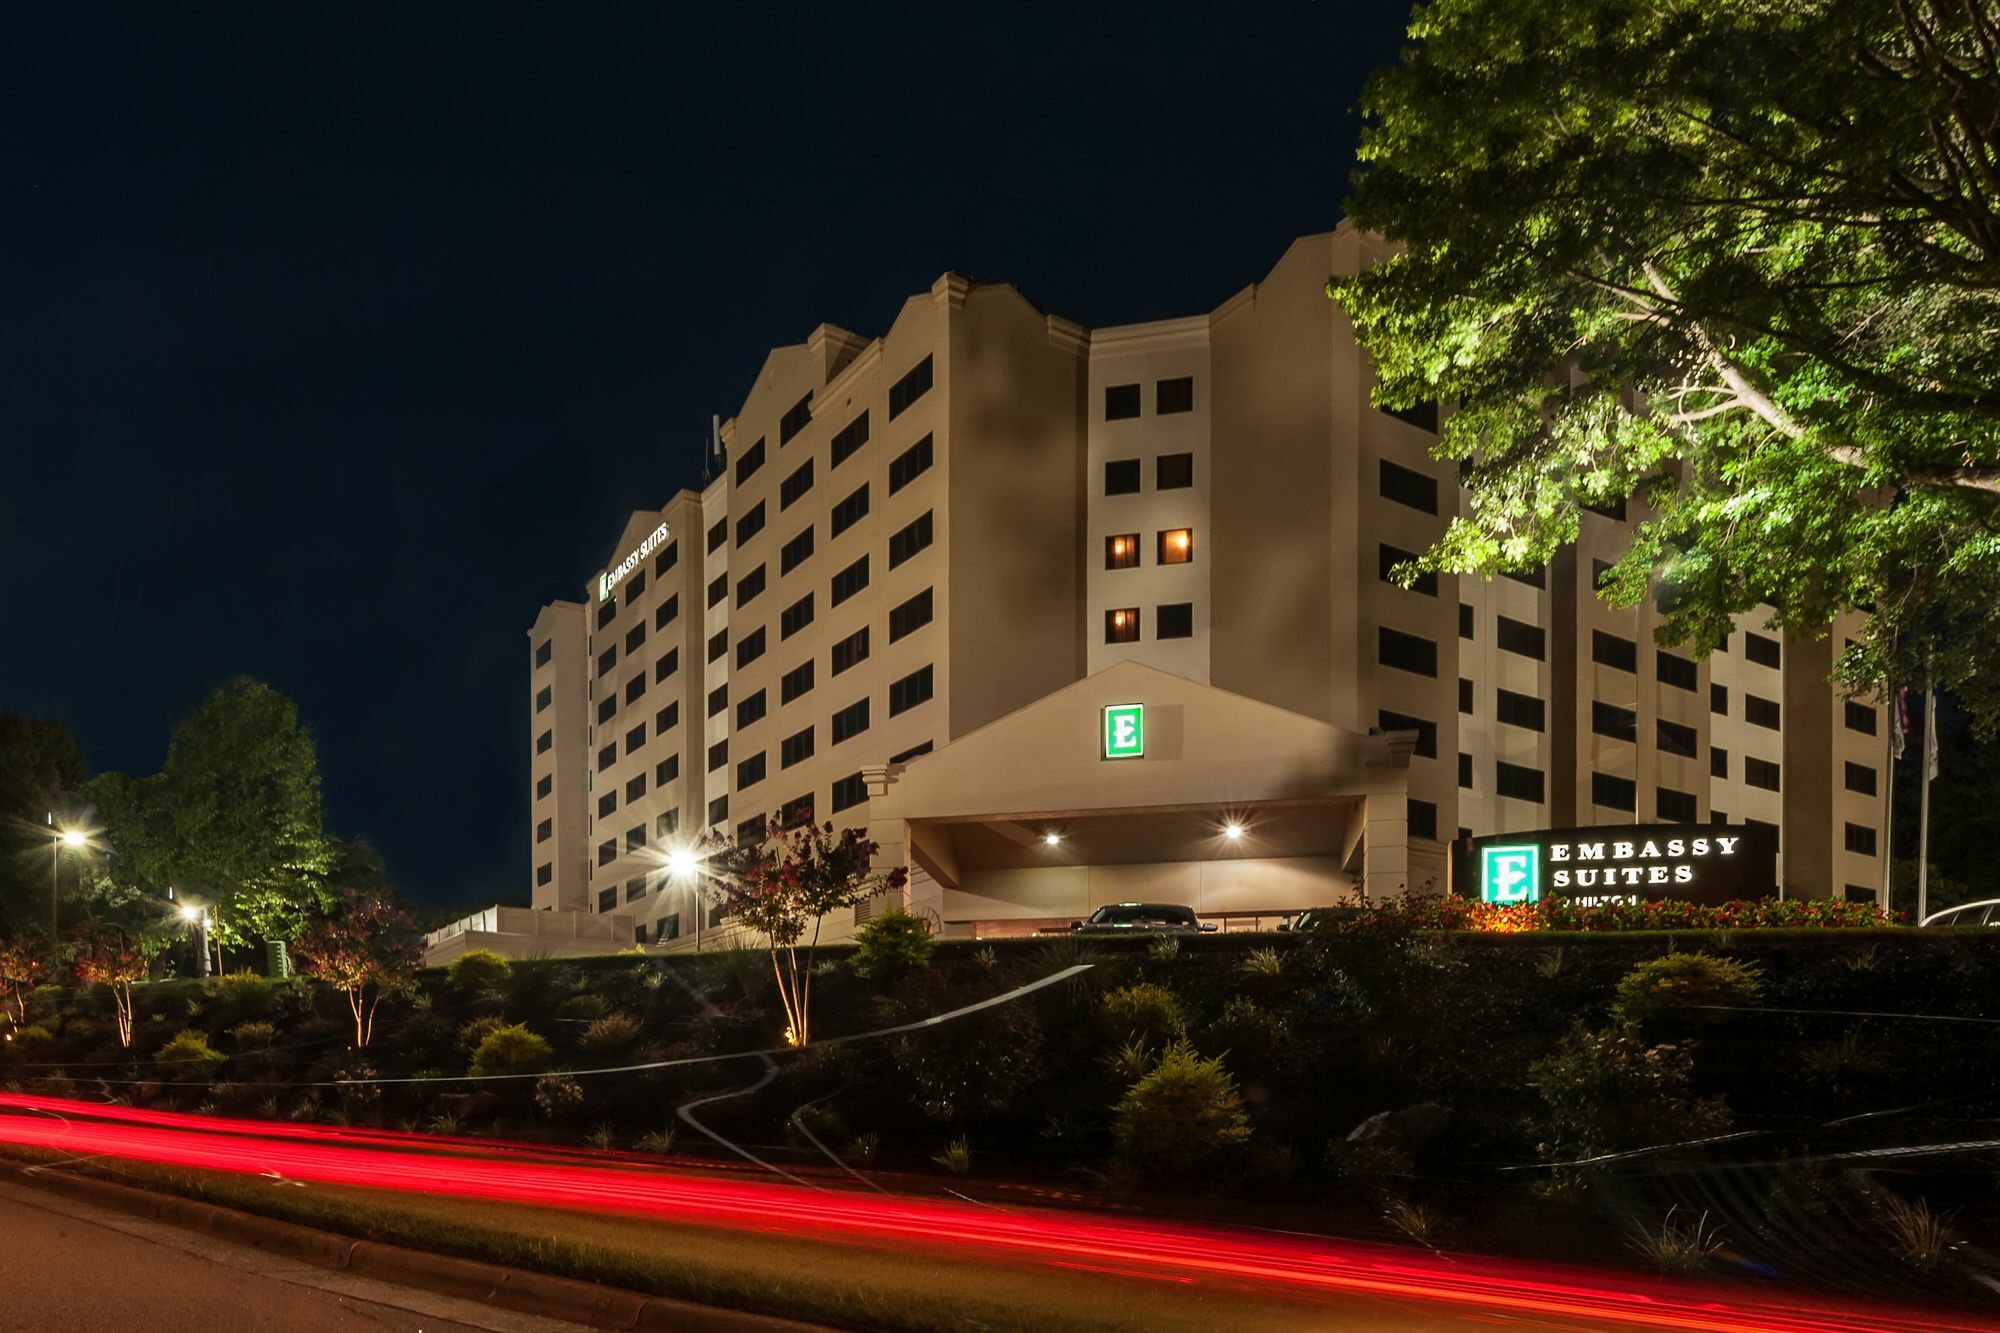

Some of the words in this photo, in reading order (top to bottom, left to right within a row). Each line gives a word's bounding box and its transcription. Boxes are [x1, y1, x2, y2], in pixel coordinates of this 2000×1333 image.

[608, 548, 640, 590] EMBASSY
[640, 522, 669, 560] SUITES
[1113, 715, 1137, 748] E
[1550, 837, 1739, 861] EMBASSY
[1493, 855, 1527, 901] E
[1553, 865, 1693, 888] SUITES
